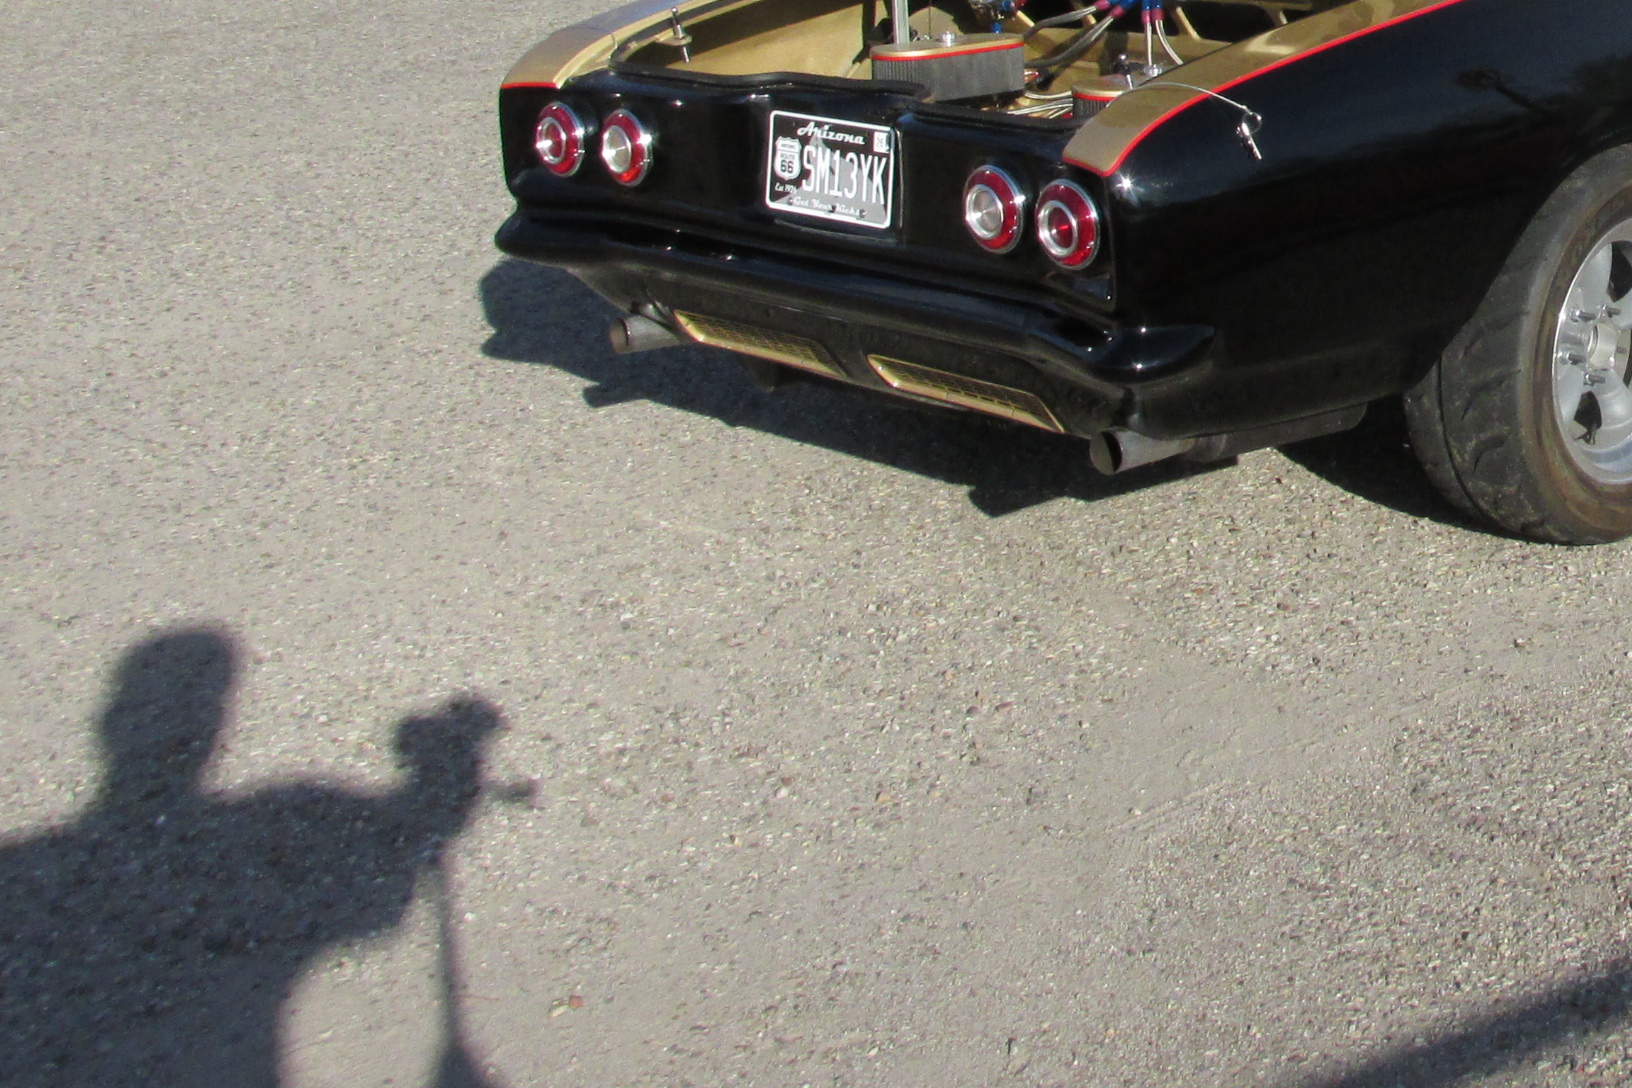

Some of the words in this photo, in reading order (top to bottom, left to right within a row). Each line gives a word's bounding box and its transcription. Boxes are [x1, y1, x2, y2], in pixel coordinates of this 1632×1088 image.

[797, 121, 865, 145] Arizona
[780, 159, 794, 174] 66
[801, 144, 887, 205] SM13YK
